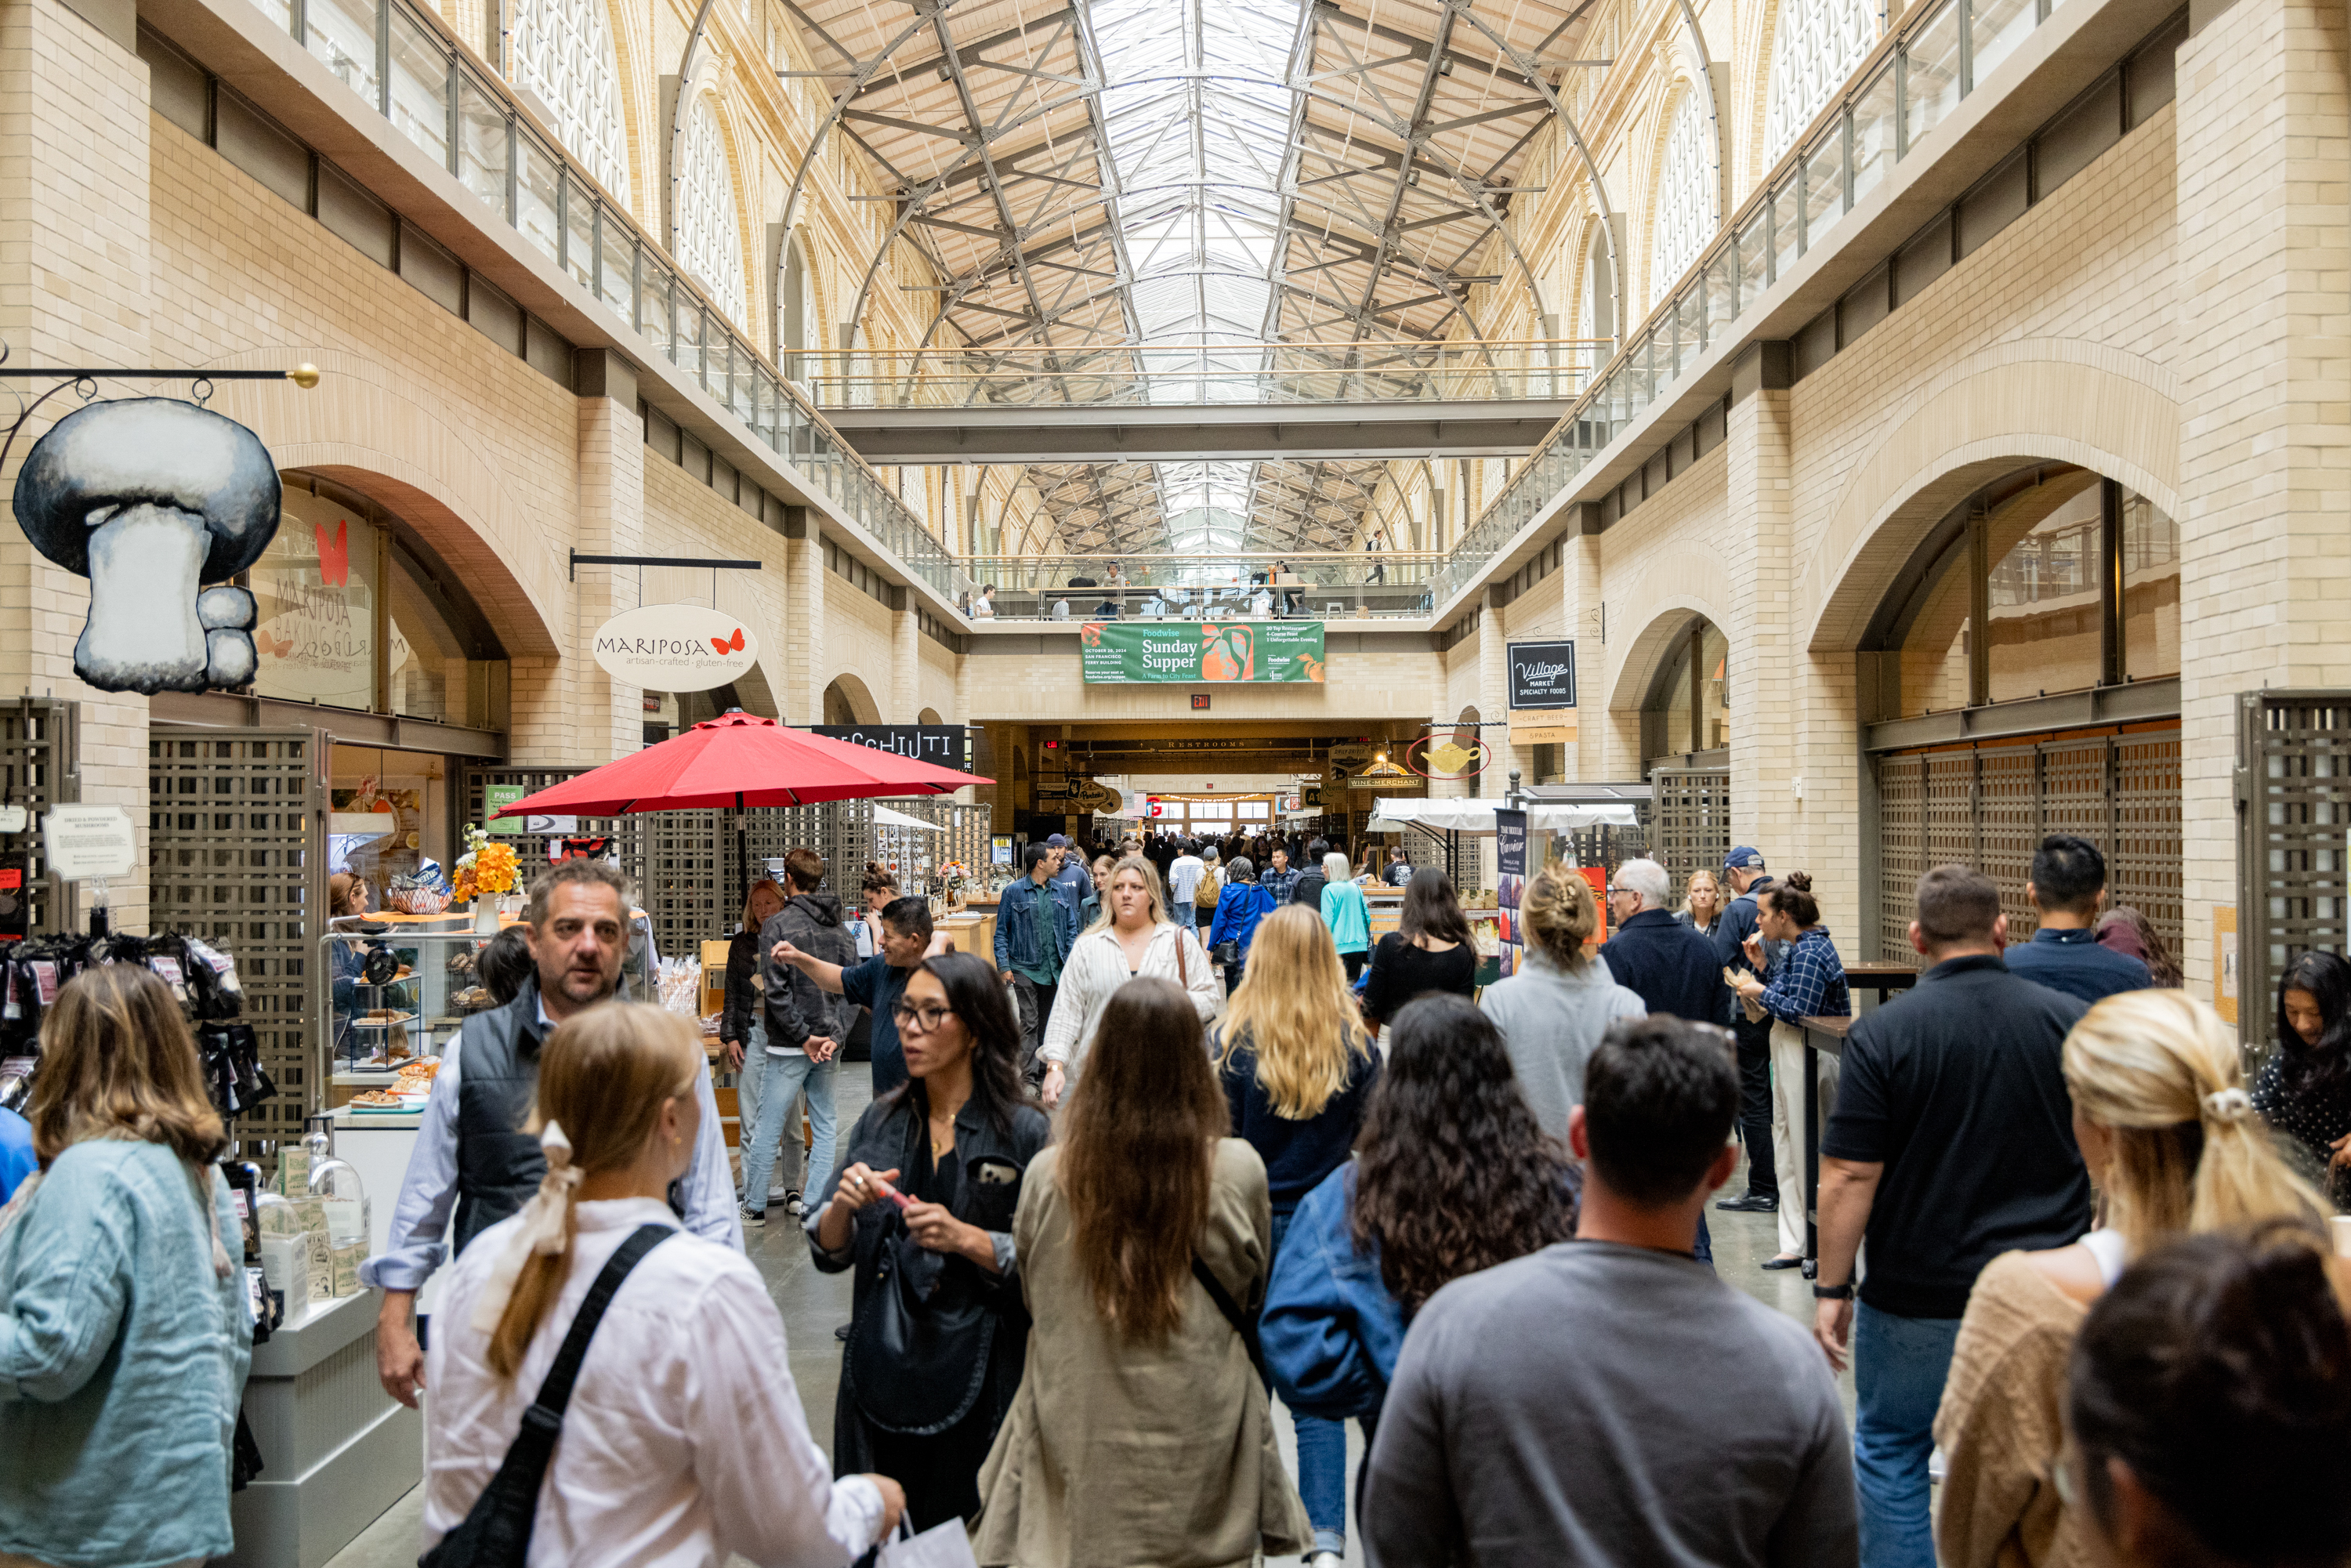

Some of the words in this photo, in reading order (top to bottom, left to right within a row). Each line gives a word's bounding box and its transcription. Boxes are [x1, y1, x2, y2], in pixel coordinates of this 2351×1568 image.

[276, 578, 351, 628] MARIPOSA
[1143, 628, 1179, 637] Foodwise
[597, 638, 708, 656] MARIPOSA
[1142, 639, 1197, 657] Sunday
[626, 657, 690, 666] artisan-crafted
[696, 658, 744, 668] gluten-free
[1143, 654, 1197, 672] Supper
[1516, 661, 1567, 680] Village
[1194, 696, 1208, 707] EXIT
